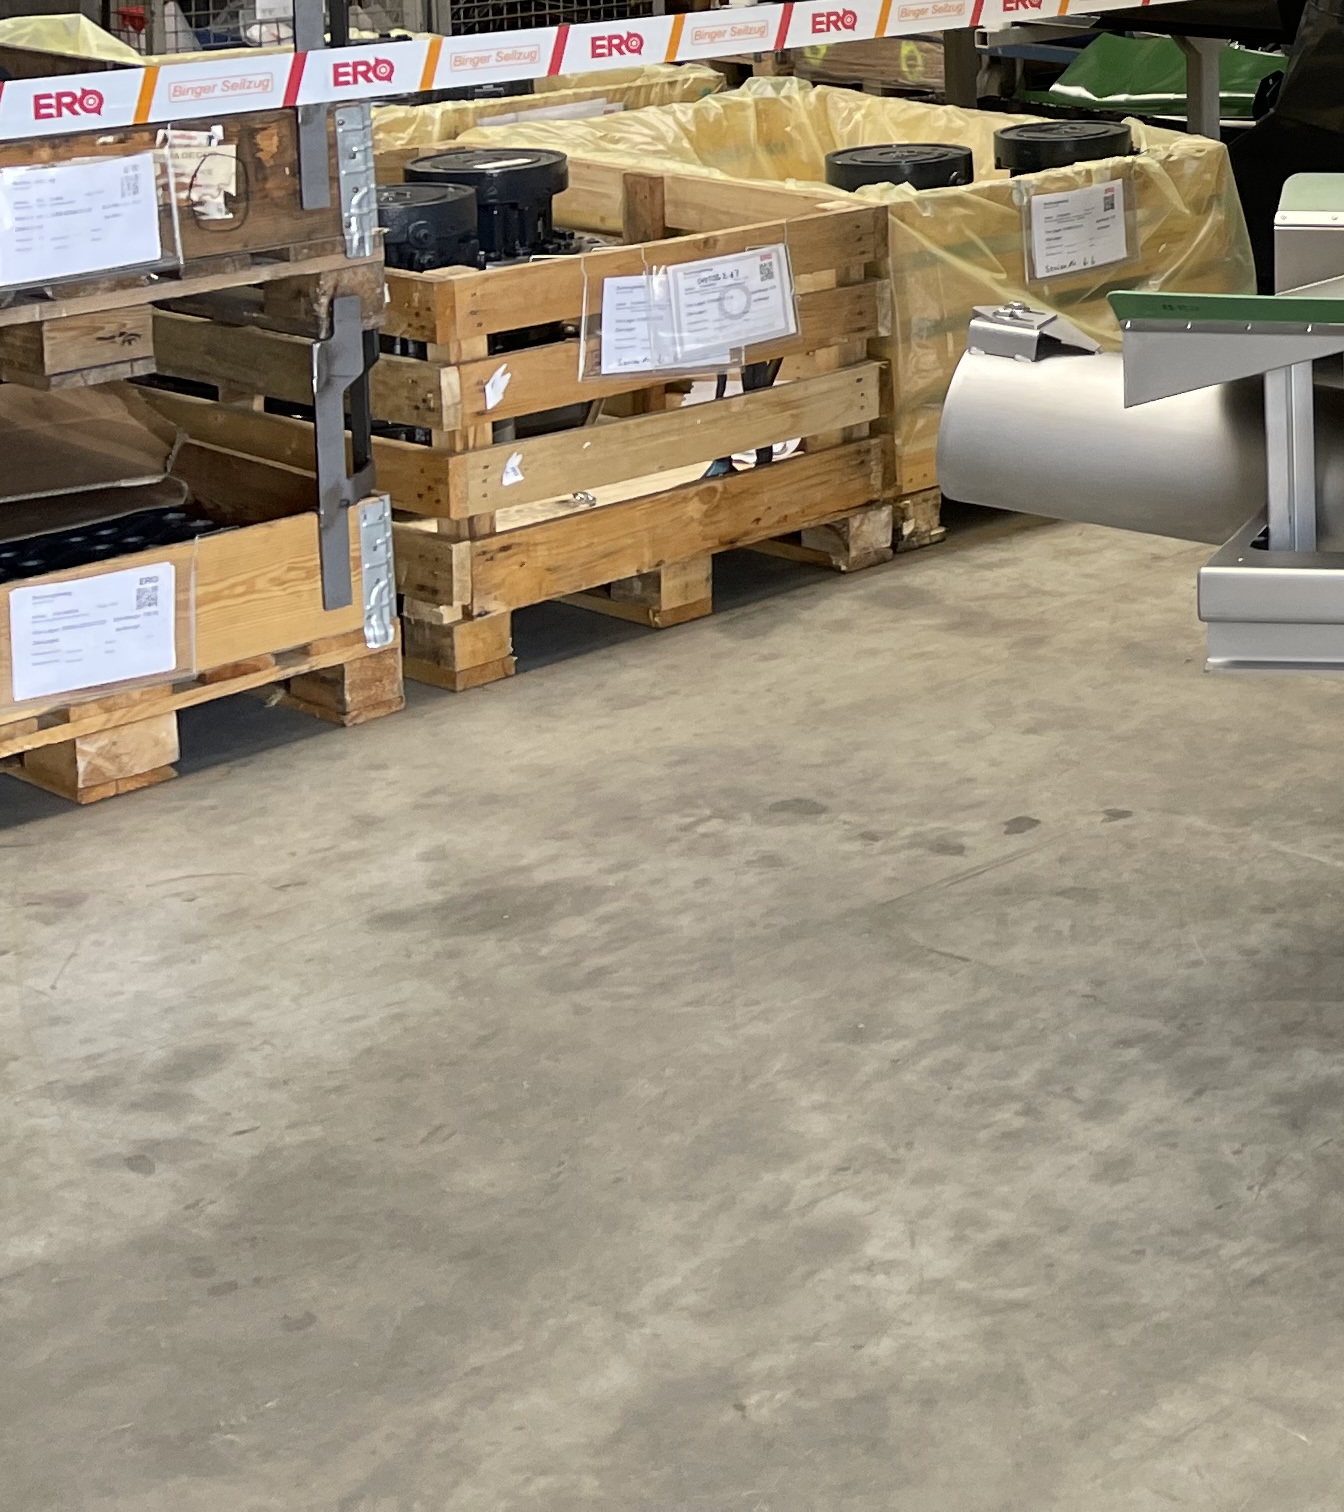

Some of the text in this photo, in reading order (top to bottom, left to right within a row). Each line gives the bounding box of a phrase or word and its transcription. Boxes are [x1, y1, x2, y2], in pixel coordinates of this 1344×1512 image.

[171, 83, 216, 99] Binger
[220, 75, 271, 93] Seilzug
[453, 51, 493, 68] Binger
[495, 46, 538, 64] Seilzug
[694, 26, 727, 42] Binger
[729, 22, 767, 38] Seilzug
[900, 4, 929, 19] Binger
[931, 0, 963, 16] Seilzug
